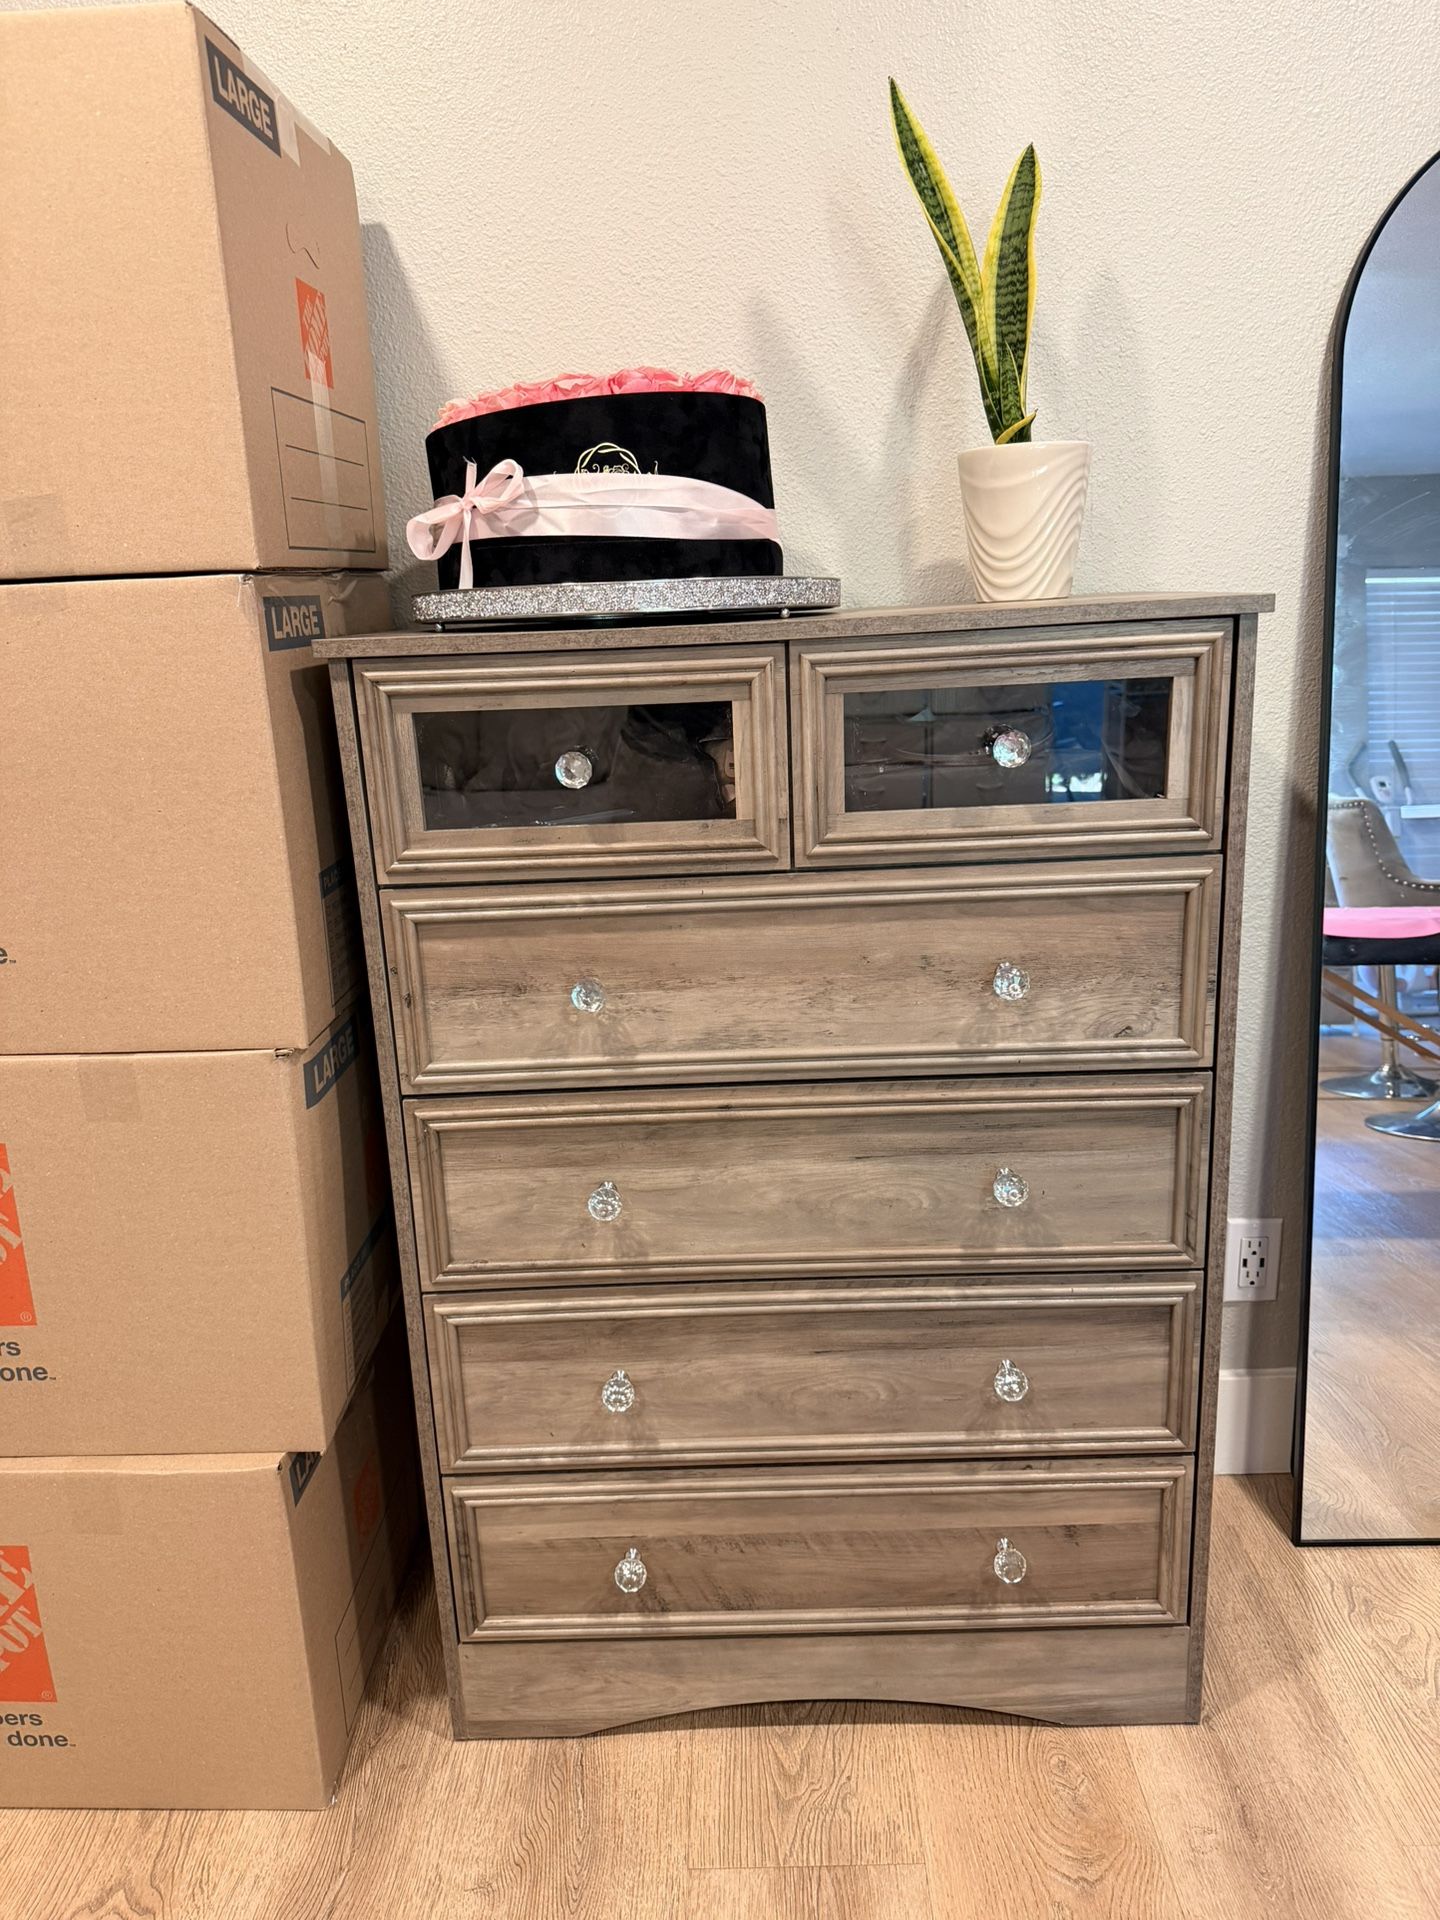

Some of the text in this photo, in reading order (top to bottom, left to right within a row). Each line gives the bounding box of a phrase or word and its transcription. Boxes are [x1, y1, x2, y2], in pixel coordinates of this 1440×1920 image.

[213, 55, 274, 141] LARGE
[271, 604, 321, 640] LARGE
[313, 1023, 354, 1094] LARGE
[0, 1713, 43, 1726] ers
